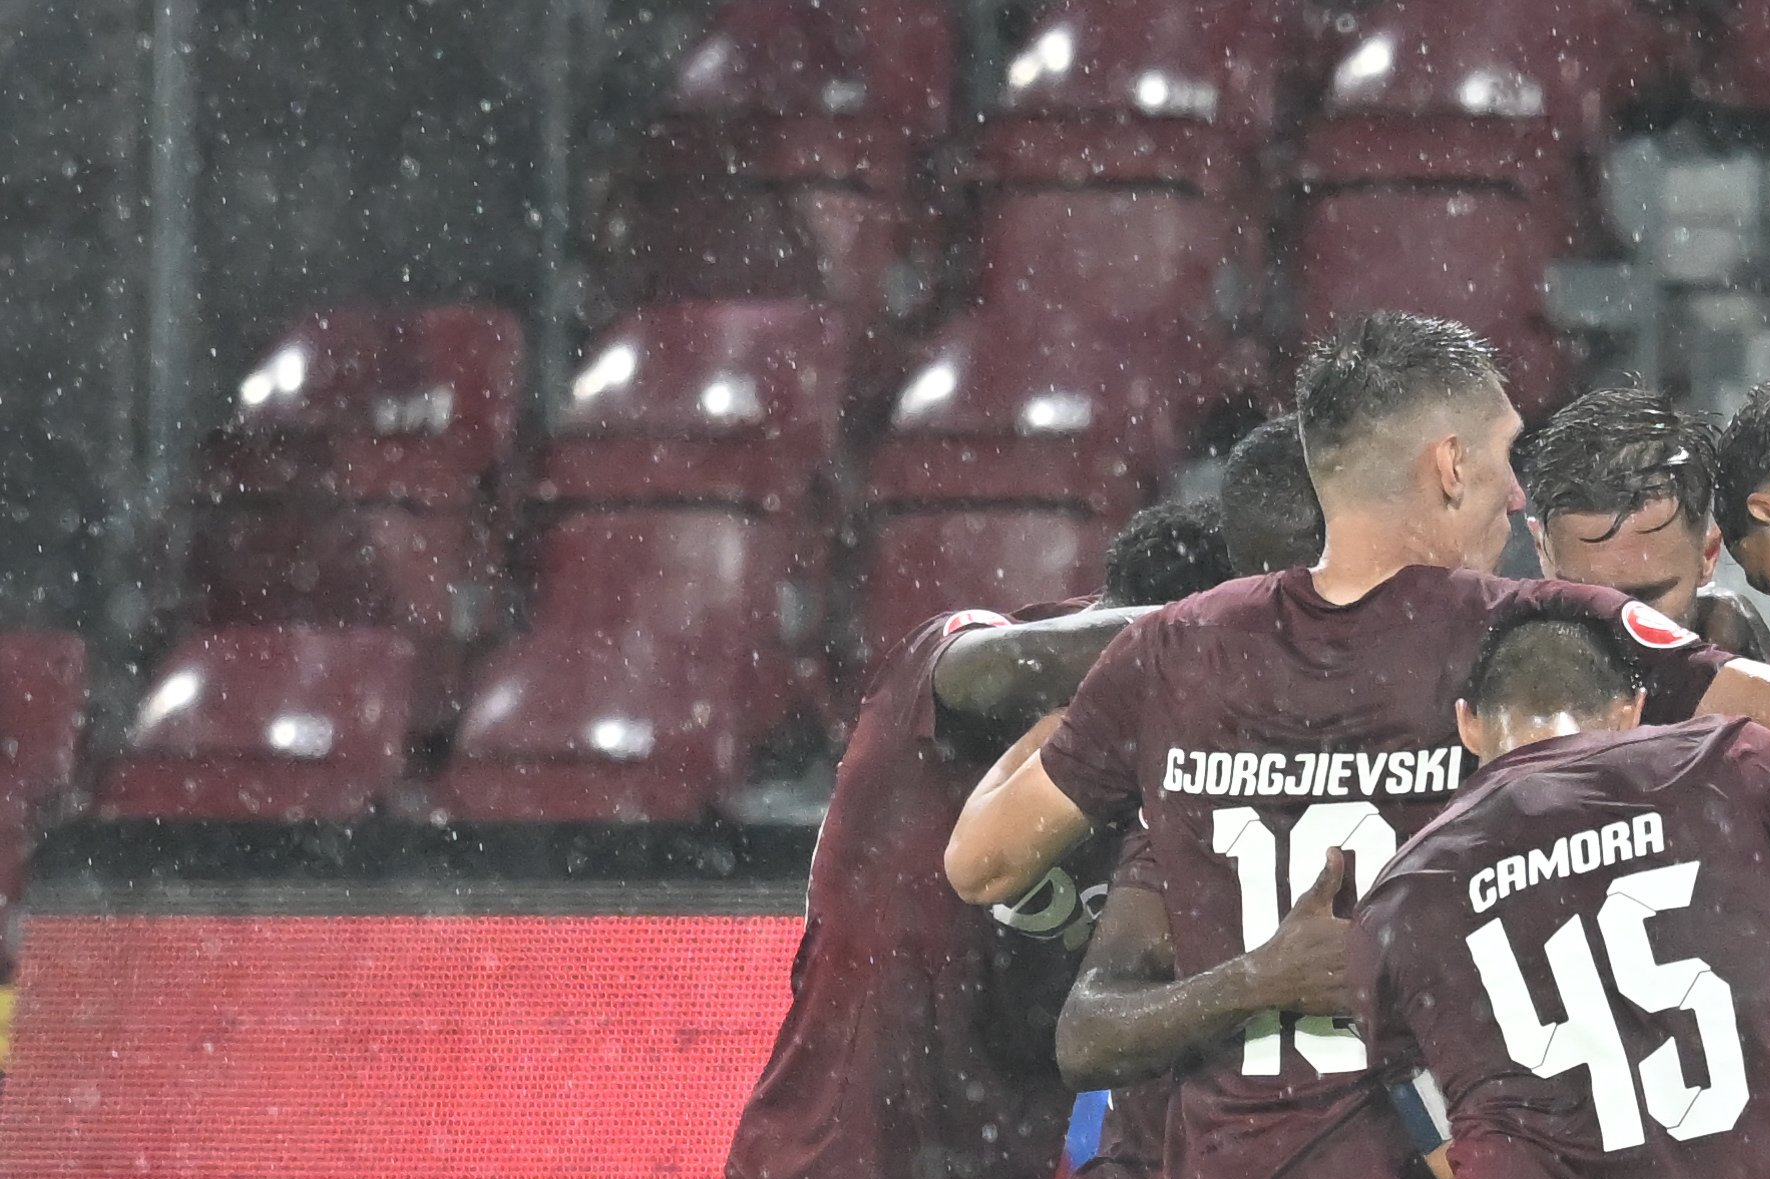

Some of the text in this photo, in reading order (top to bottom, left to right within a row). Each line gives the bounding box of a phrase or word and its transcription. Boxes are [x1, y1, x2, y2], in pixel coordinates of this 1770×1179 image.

[1162, 745, 1463, 796] GJORGJIEVSKI
[1468, 811, 1665, 914] CAMORA
[1465, 860, 1751, 1153] 45
